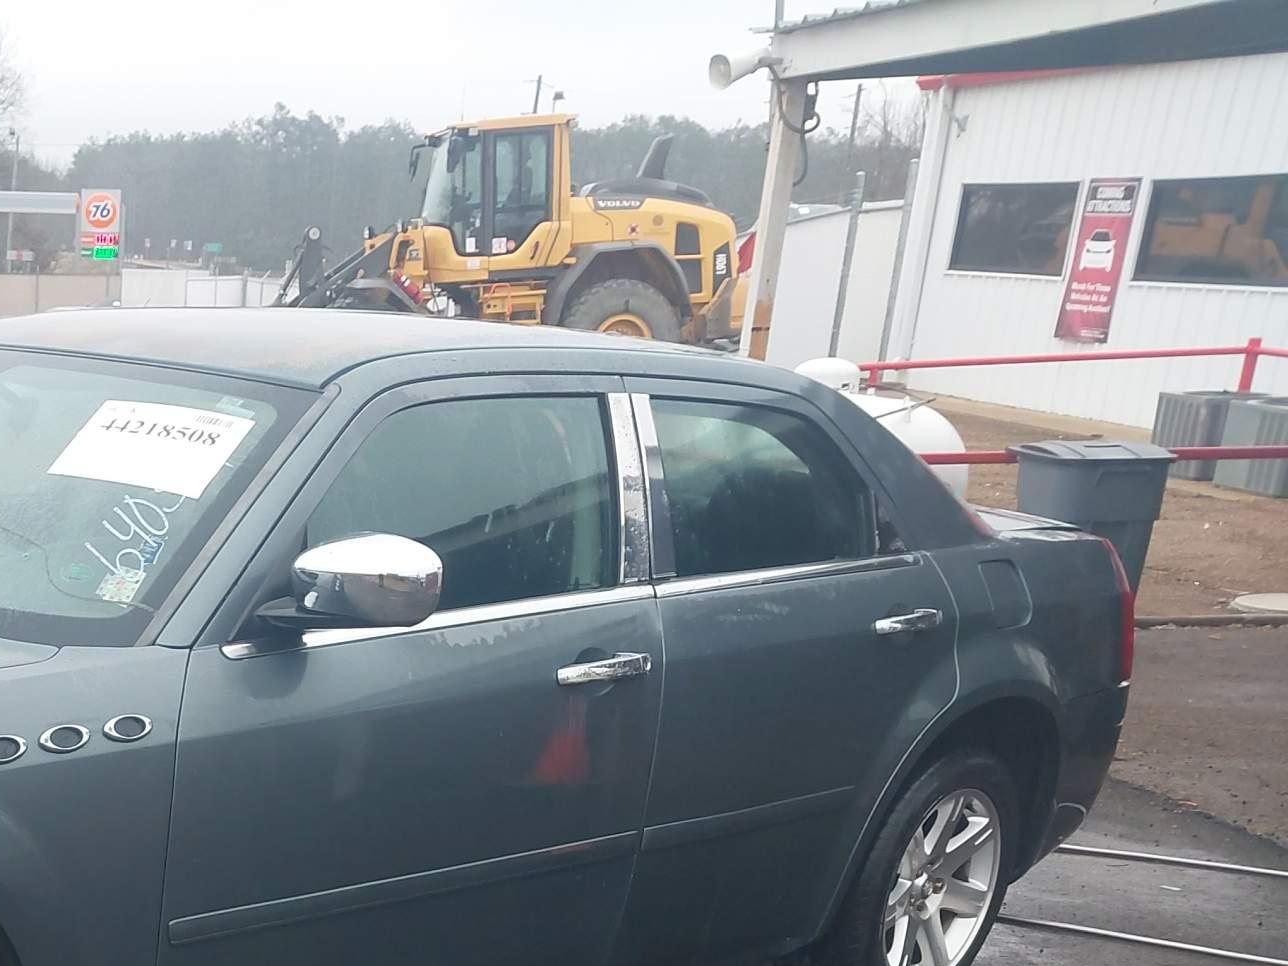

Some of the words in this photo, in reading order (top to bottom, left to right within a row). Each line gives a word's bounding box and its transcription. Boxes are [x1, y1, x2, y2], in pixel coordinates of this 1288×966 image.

[91, 202, 111, 219] 76
[597, 200, 640, 208] VOLVO
[100, 418, 221, 447] 44218508
[84, 494, 187, 582] 640
